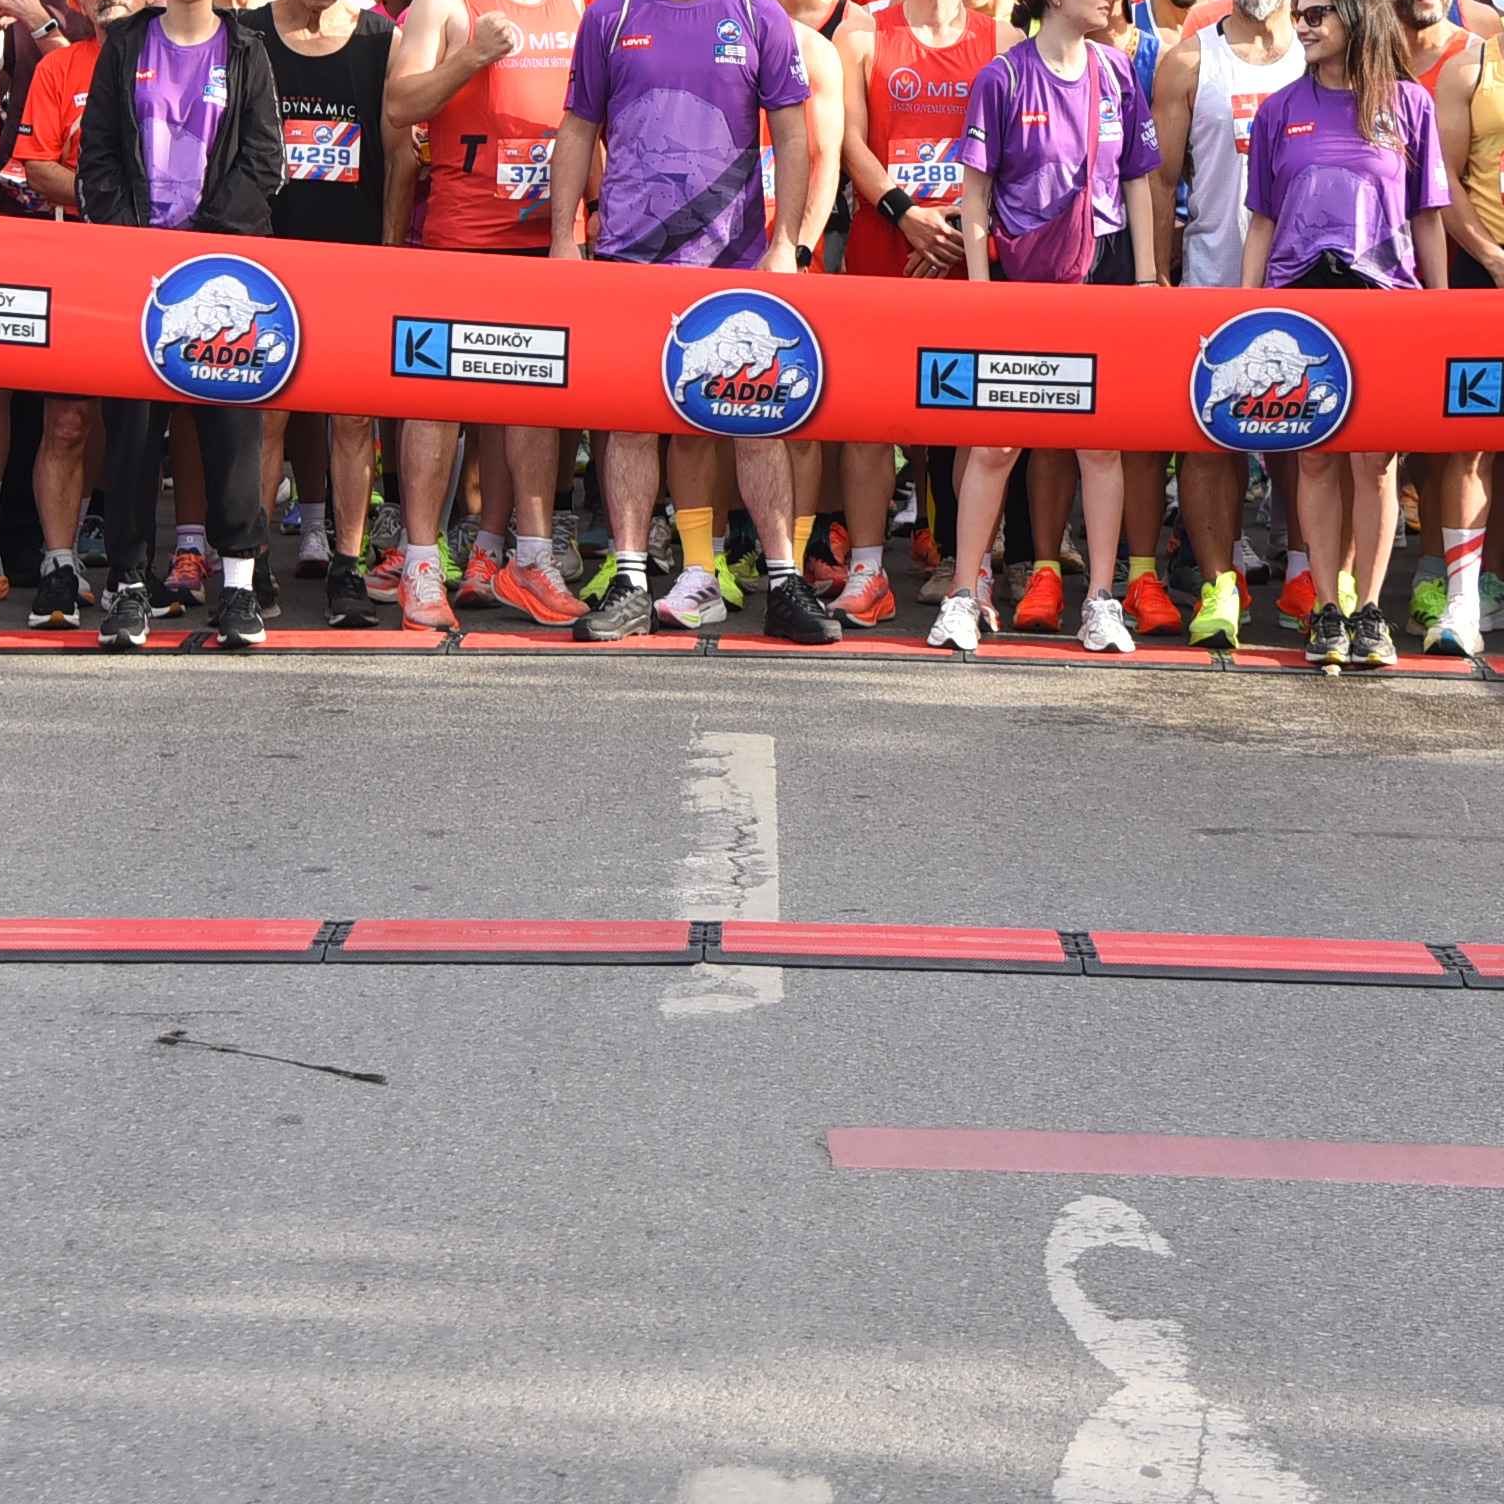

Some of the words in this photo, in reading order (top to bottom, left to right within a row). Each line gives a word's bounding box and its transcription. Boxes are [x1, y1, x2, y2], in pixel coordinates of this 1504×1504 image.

[282, 101, 356, 118] DYNAMIC
[290, 146, 351, 166] 4259
[897, 165, 957, 183] 4288
[462, 330, 534, 351] KADIKÖY
[183, 342, 267, 369] CADDE
[189, 365, 263, 386] 10K-21K
[461, 358, 554, 380] BELEDİYESİ
[989, 359, 1060, 379] KADIKÖY
[703, 377, 790, 405] CADDE
[987, 386, 1082, 408] BELEDİYESİ
[709, 401, 785, 421] 10K-21K
[1231, 398, 1319, 422] CADDE
[1237, 418, 1313, 438] 10K-21K
